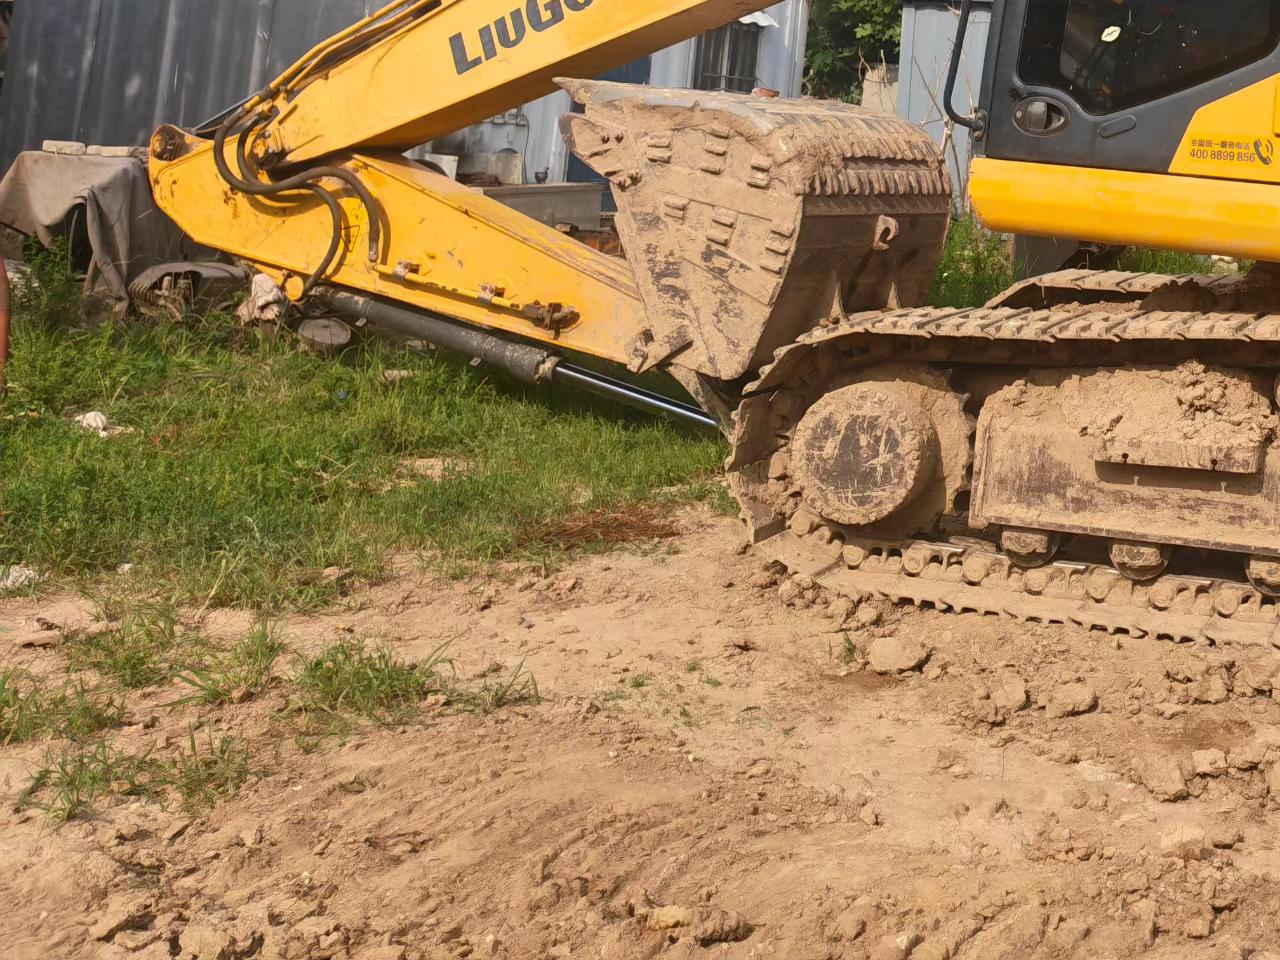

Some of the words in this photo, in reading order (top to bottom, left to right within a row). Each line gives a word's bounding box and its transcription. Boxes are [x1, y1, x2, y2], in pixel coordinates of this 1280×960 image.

[1190, 148, 1208, 159] 400
[1210, 150, 1235, 161] 8899
[1237, 152, 1256, 163] 856
